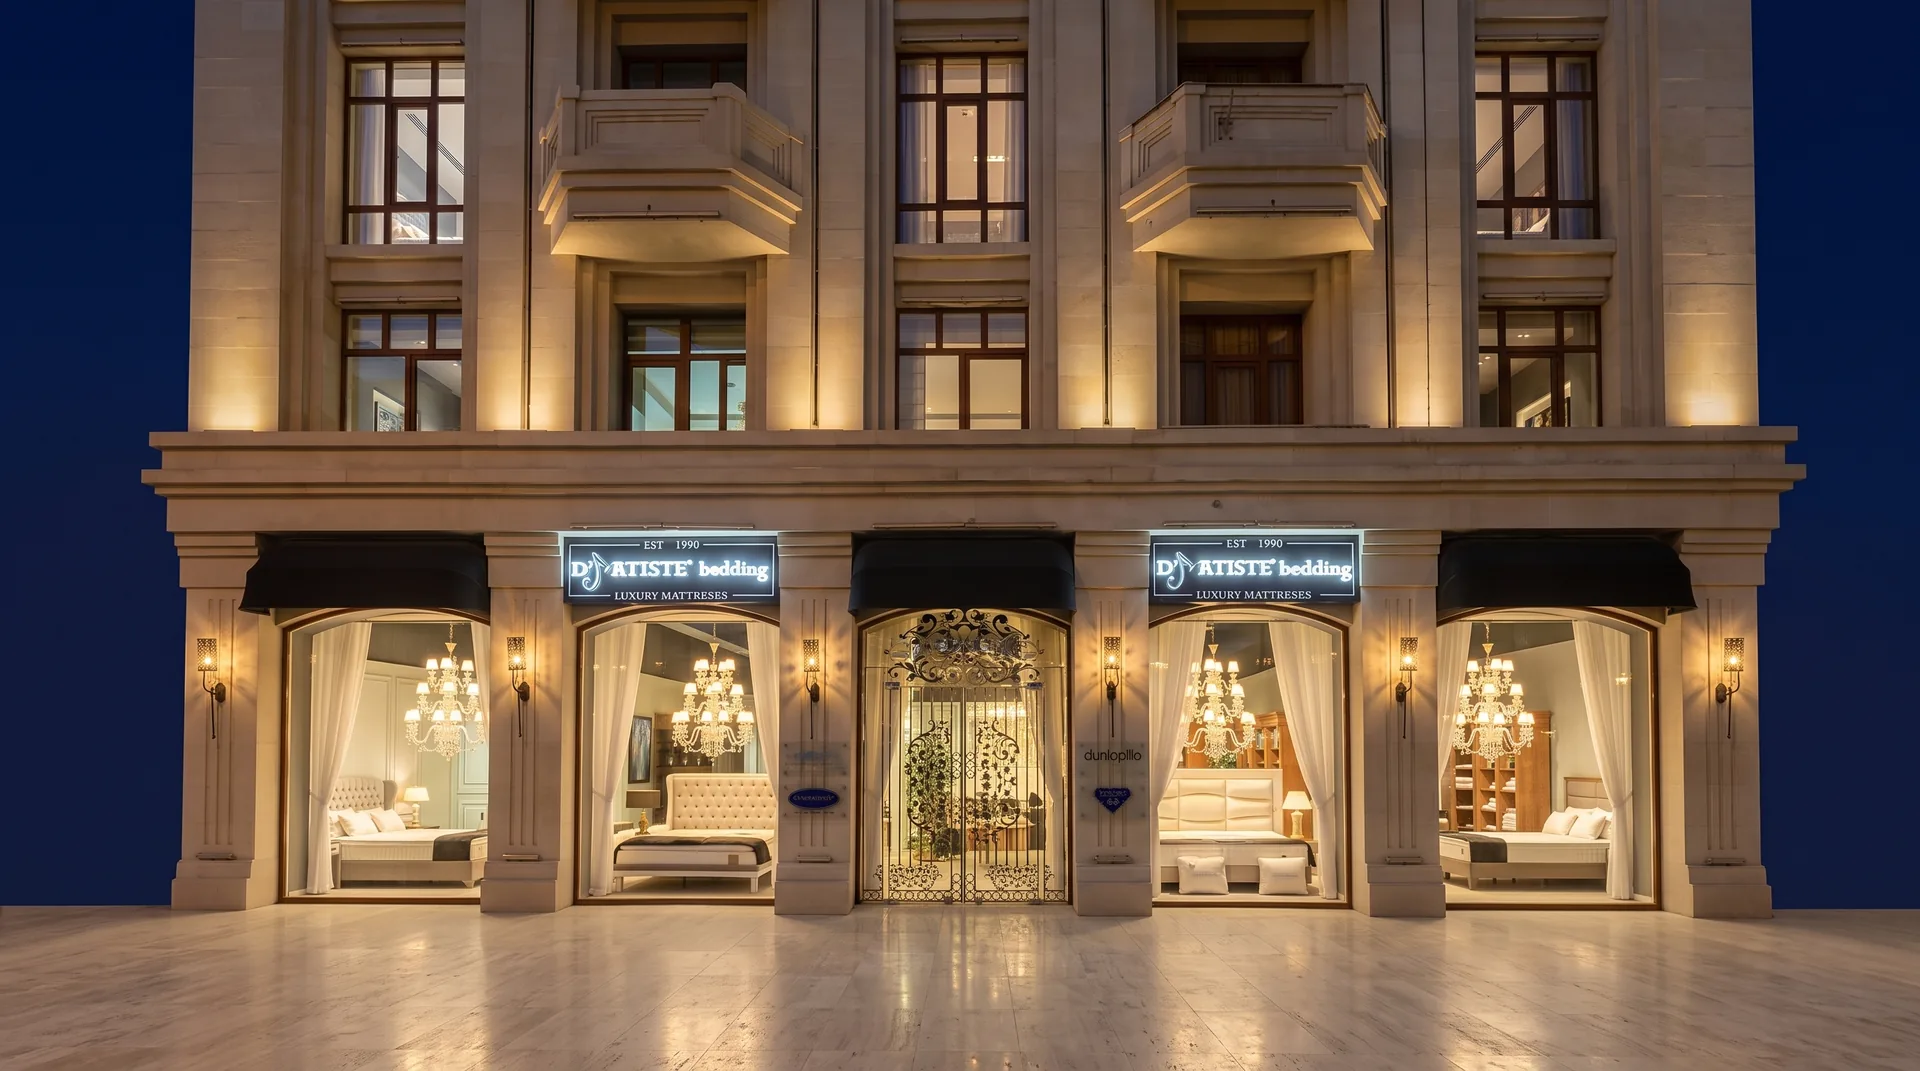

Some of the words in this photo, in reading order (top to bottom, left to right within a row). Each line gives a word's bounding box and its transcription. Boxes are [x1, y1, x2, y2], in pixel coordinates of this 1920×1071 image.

[644, 540, 664, 550] EST
[676, 540, 700, 549] 1990
[1226, 539, 1247, 548] EST
[1259, 539, 1283, 548] 1990
[699, 560, 769, 582] bedding
[1279, 559, 1352, 582] bedding
[614, 591, 659, 600] LUXURY
[661, 591, 728, 600] MATTRESES
[1196, 590, 1241, 599] LUXURY
[1244, 590, 1312, 599] MATTRESES
